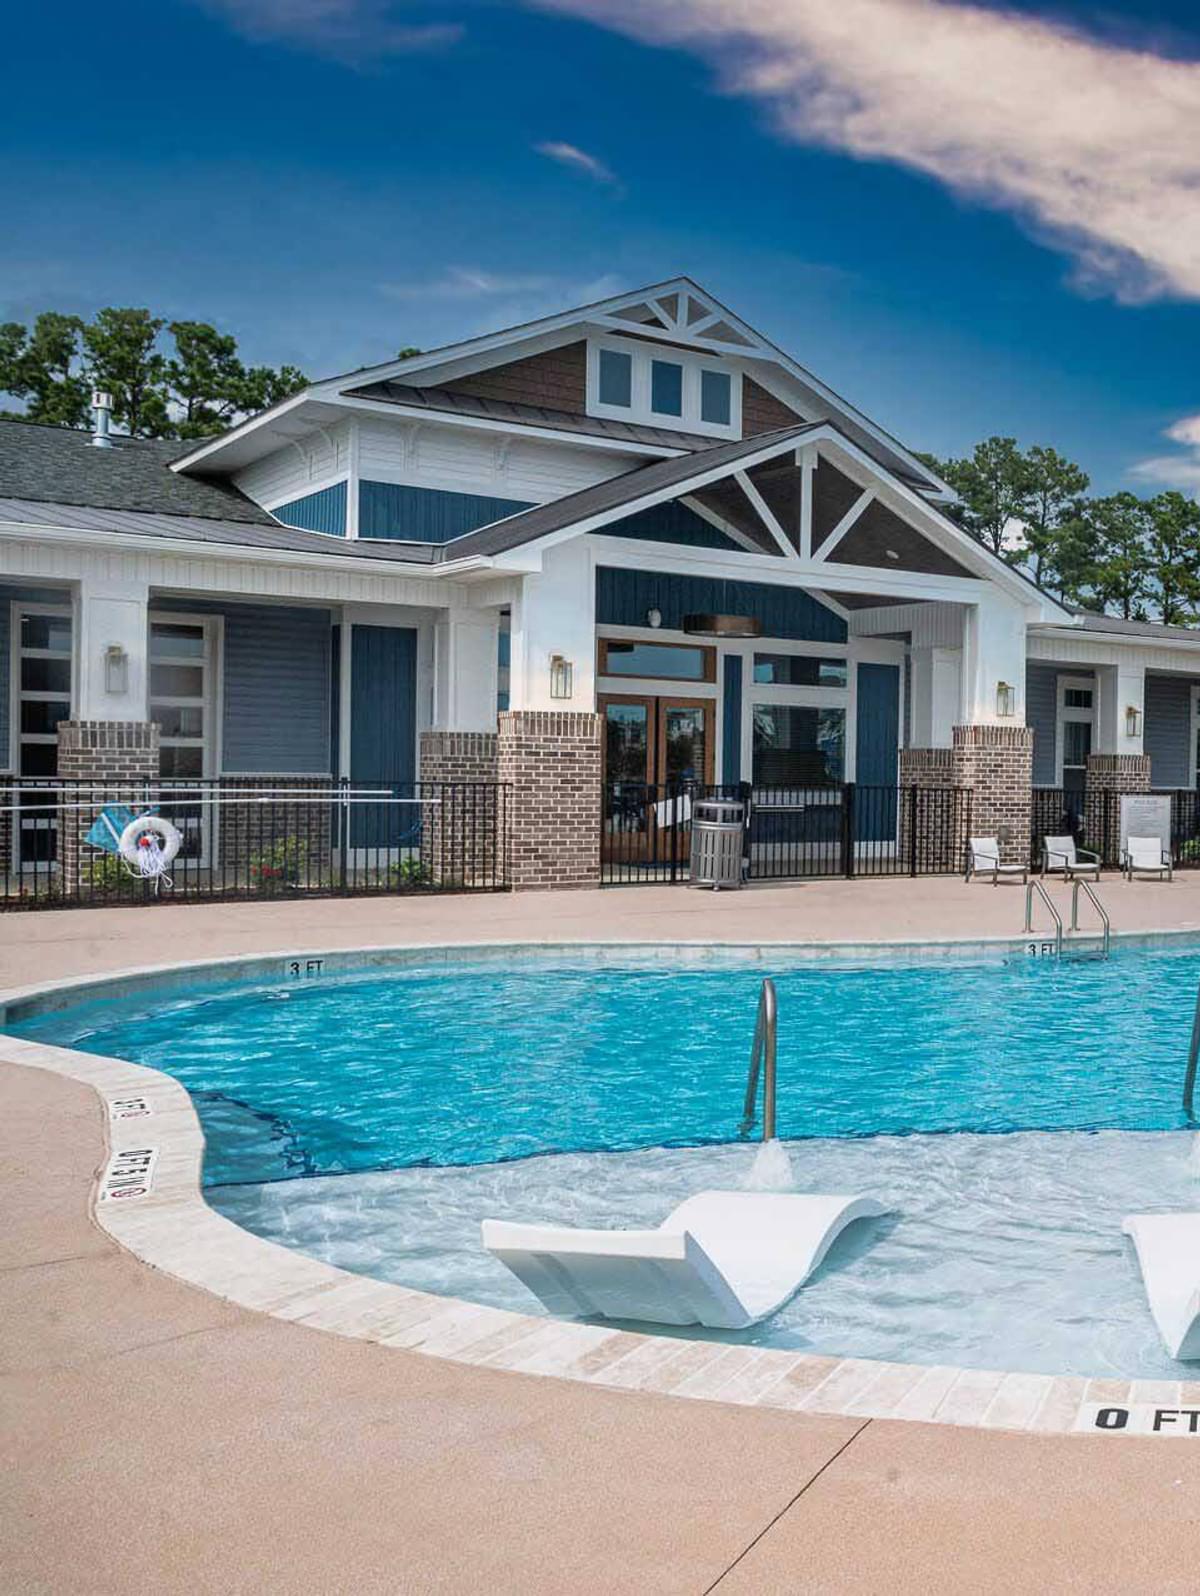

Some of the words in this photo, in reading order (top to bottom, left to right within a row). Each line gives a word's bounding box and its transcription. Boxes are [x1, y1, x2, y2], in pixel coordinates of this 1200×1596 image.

[1028, 943, 1037, 958] 3
[1041, 943, 1055, 957] FT
[290, 961, 300, 977] 3
[306, 960, 324, 977] FT
[118, 1149, 153, 1157] 0
[113, 1156, 152, 1167] FT
[111, 1168, 147, 1176] 5
[106, 1176, 146, 1188] IN
[1095, 1408, 1129, 1429] 0
